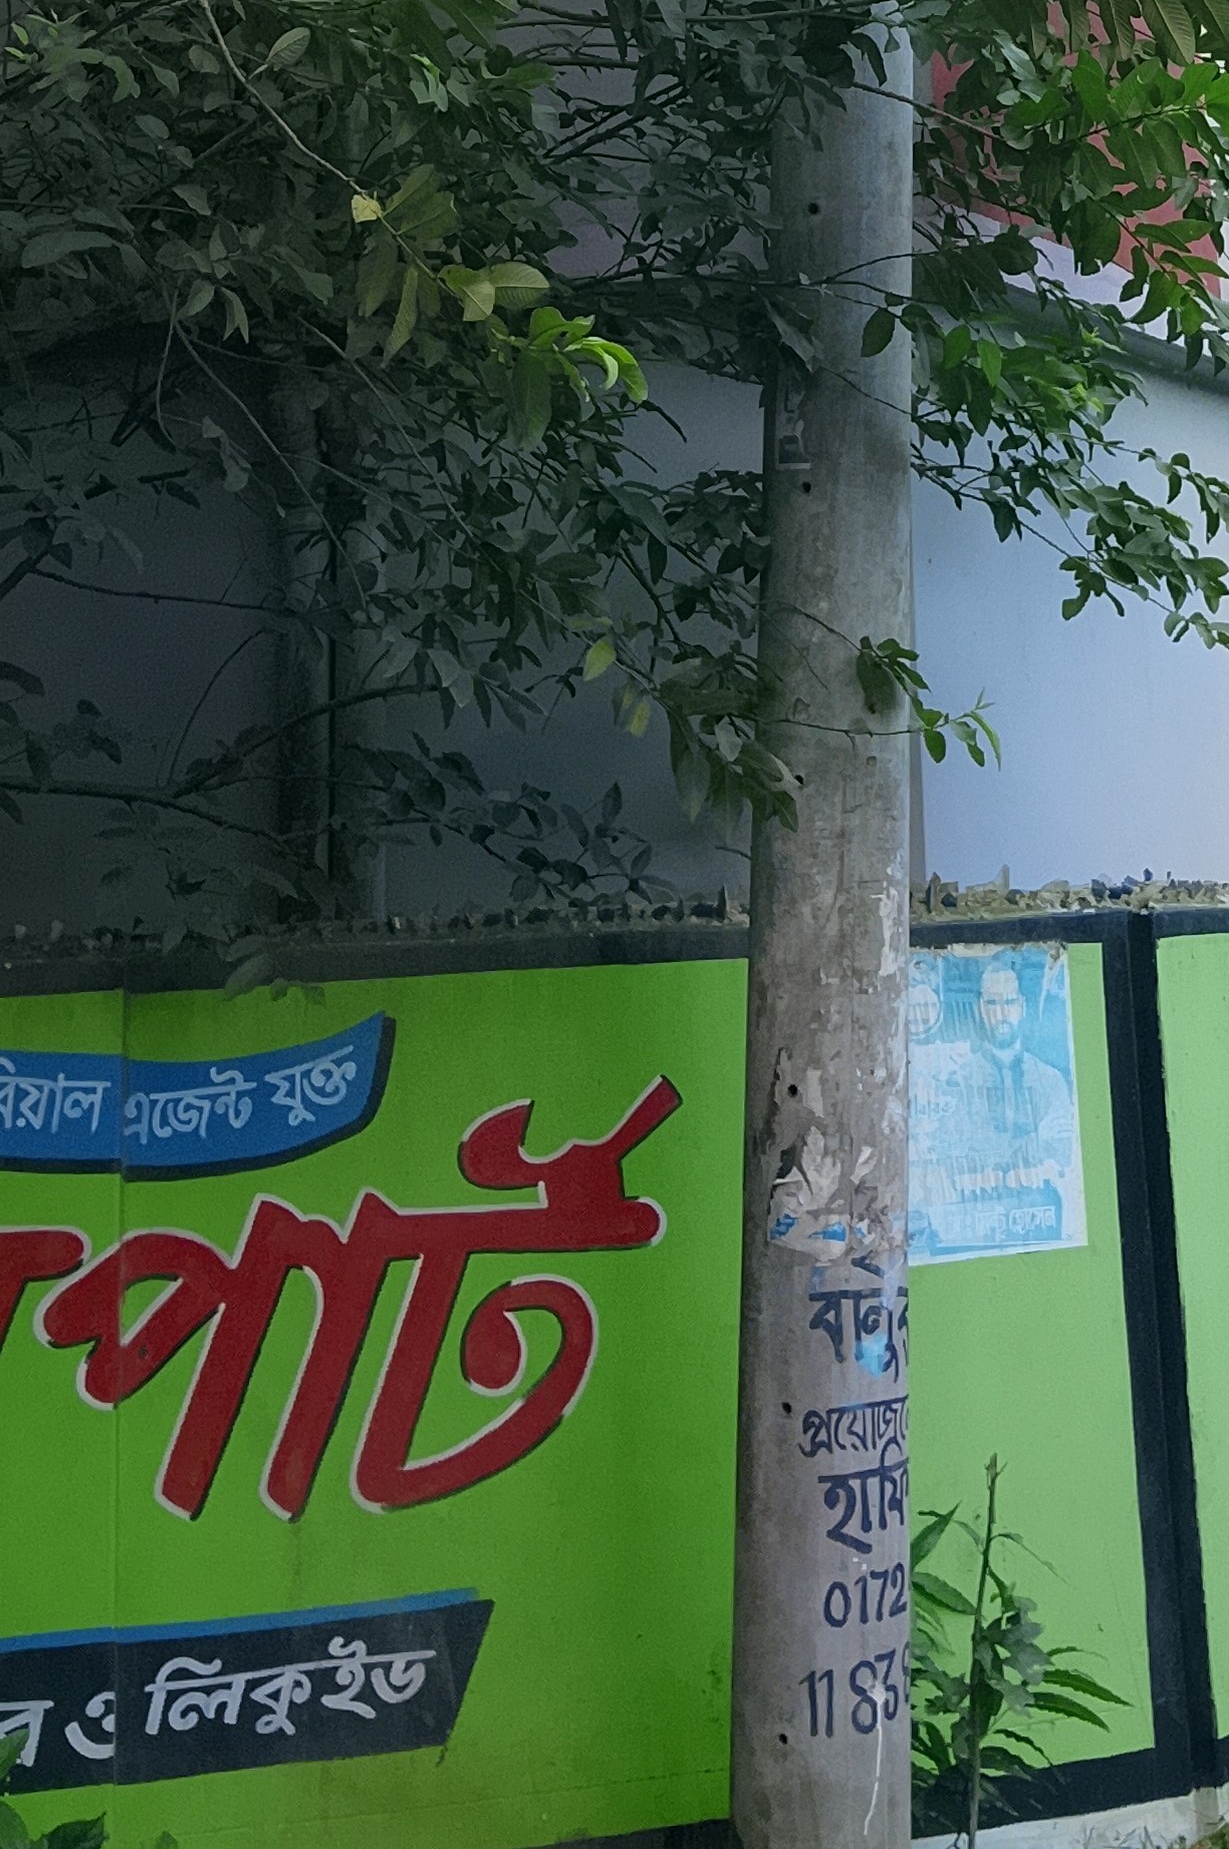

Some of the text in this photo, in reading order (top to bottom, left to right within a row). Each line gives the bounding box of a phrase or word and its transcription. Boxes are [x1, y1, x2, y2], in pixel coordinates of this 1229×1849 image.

[123, 1066, 257, 1145] এজেন্ট
[264, 1046, 357, 1127] যুক্ত
[0, 1074, 683, 1523] পার্ট
[144, 1636, 437, 1736] লিকুইড
